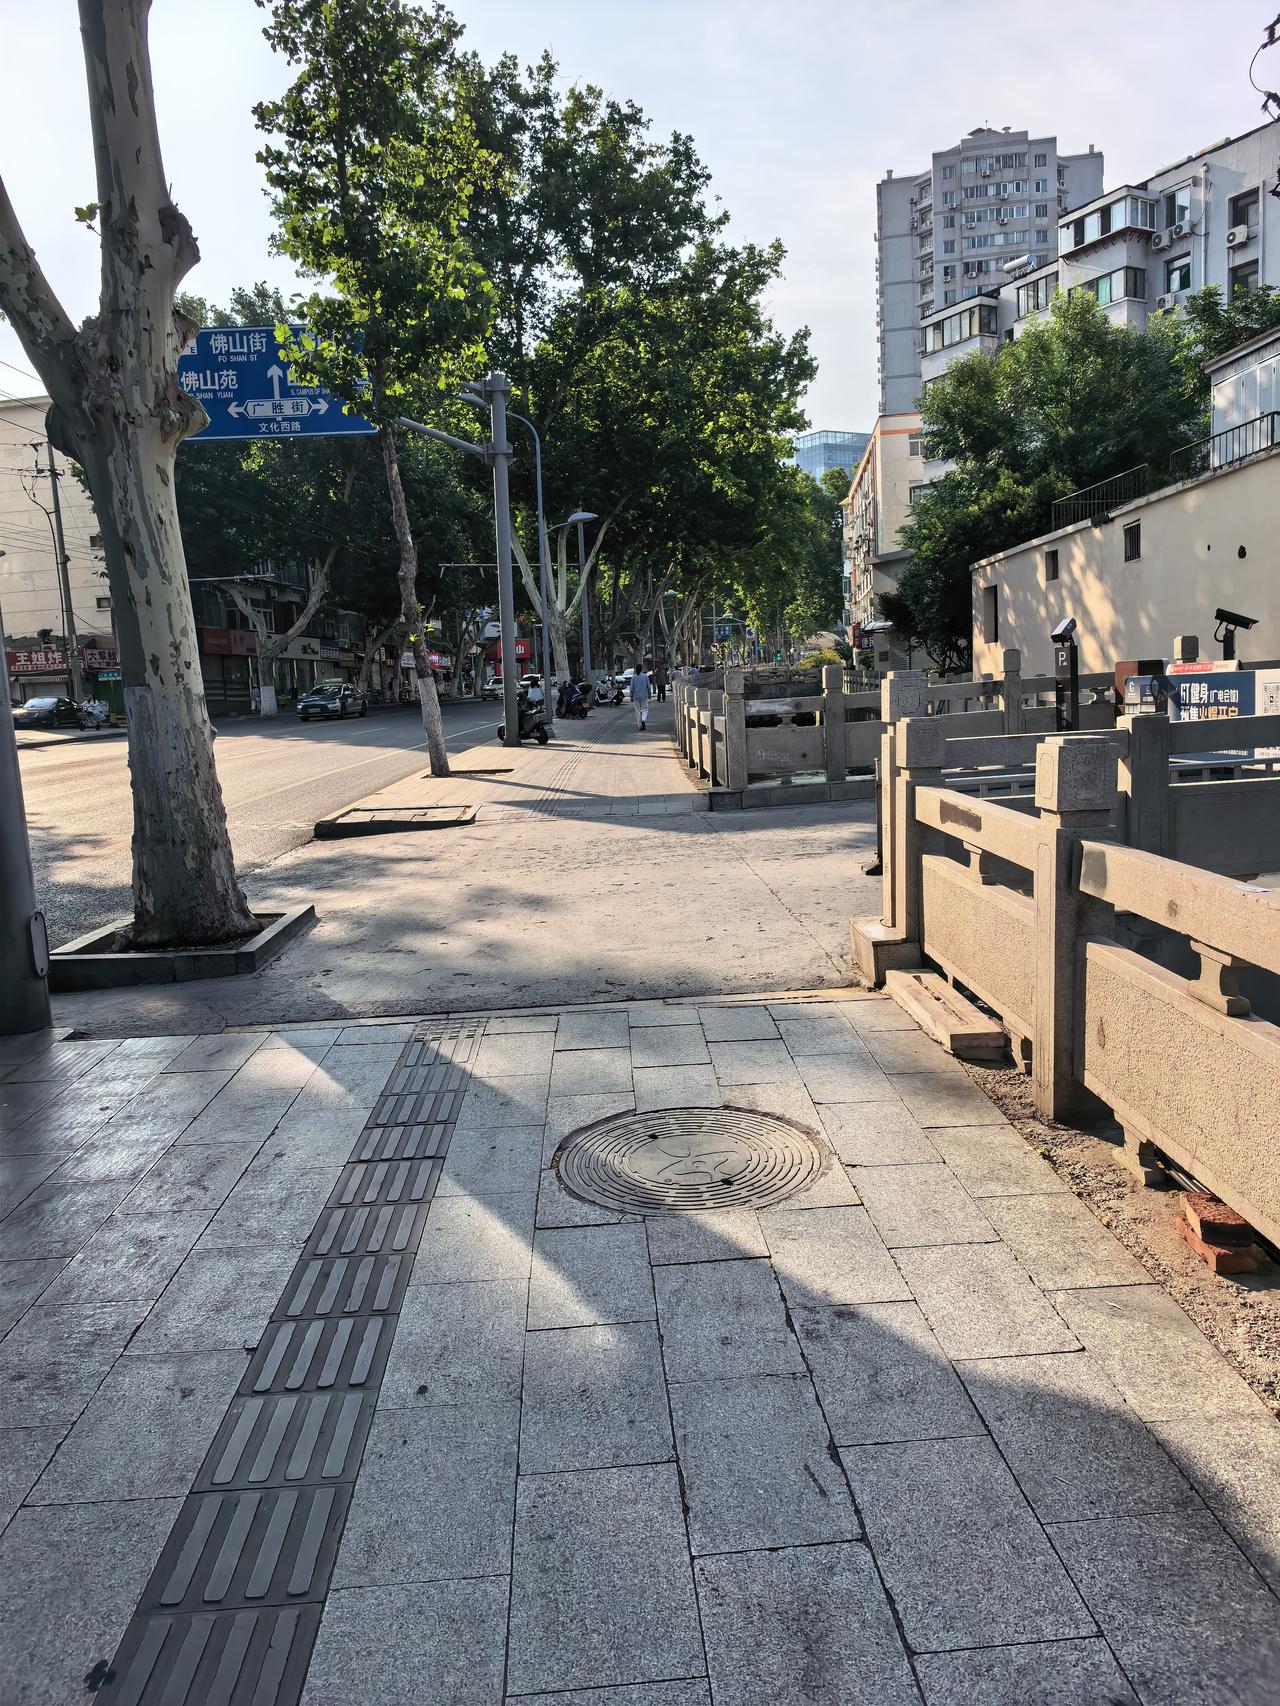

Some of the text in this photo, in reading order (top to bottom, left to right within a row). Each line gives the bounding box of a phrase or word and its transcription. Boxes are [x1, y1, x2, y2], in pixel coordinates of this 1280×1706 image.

[209, 332, 267, 354] 佛山街
[218, 355, 227, 363] FO
[249, 354, 258, 362] ST
[180, 369, 238, 391] 佛山苑
[252, 401, 305, 415] 广胜街
[258, 421, 301, 433] 文化西路
